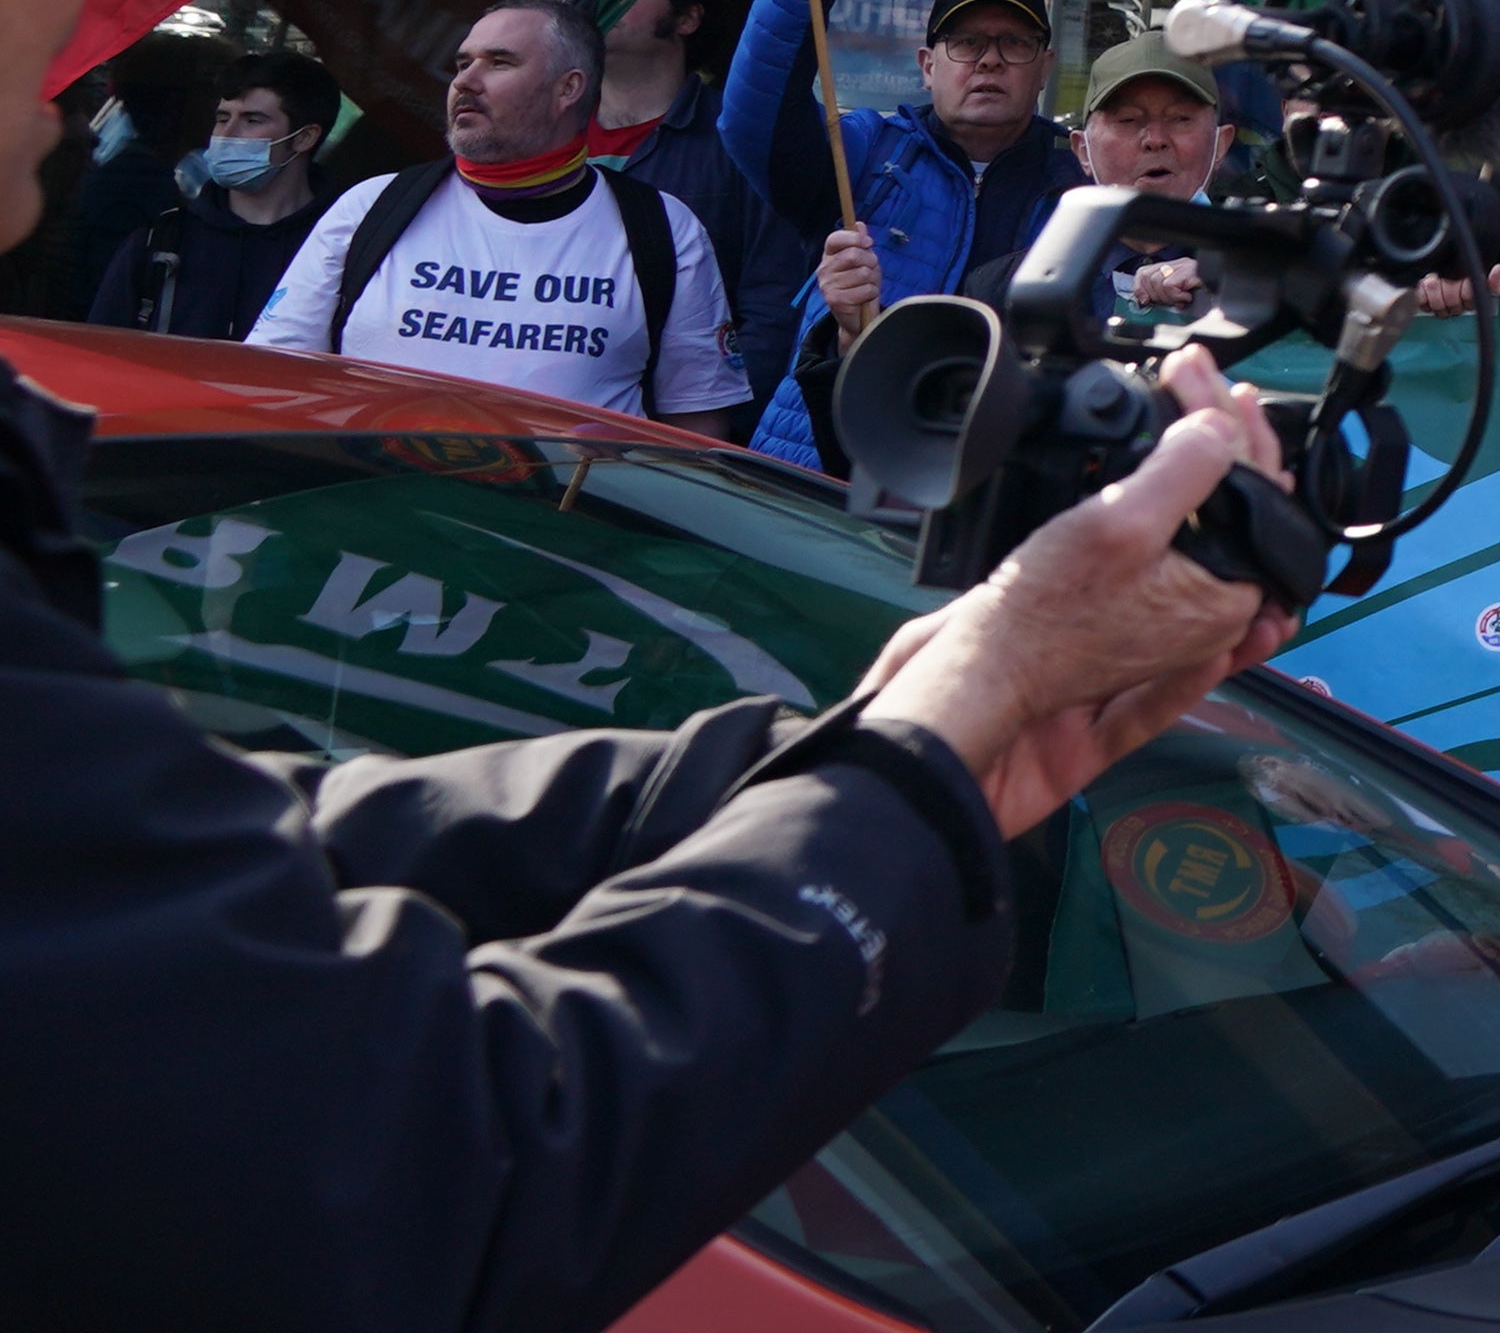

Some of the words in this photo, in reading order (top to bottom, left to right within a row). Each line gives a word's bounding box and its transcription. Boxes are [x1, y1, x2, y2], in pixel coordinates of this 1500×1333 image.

[410, 261, 521, 302] SAVE
[533, 273, 616, 309] OUR
[398, 309, 609, 358] SEAFARERS
